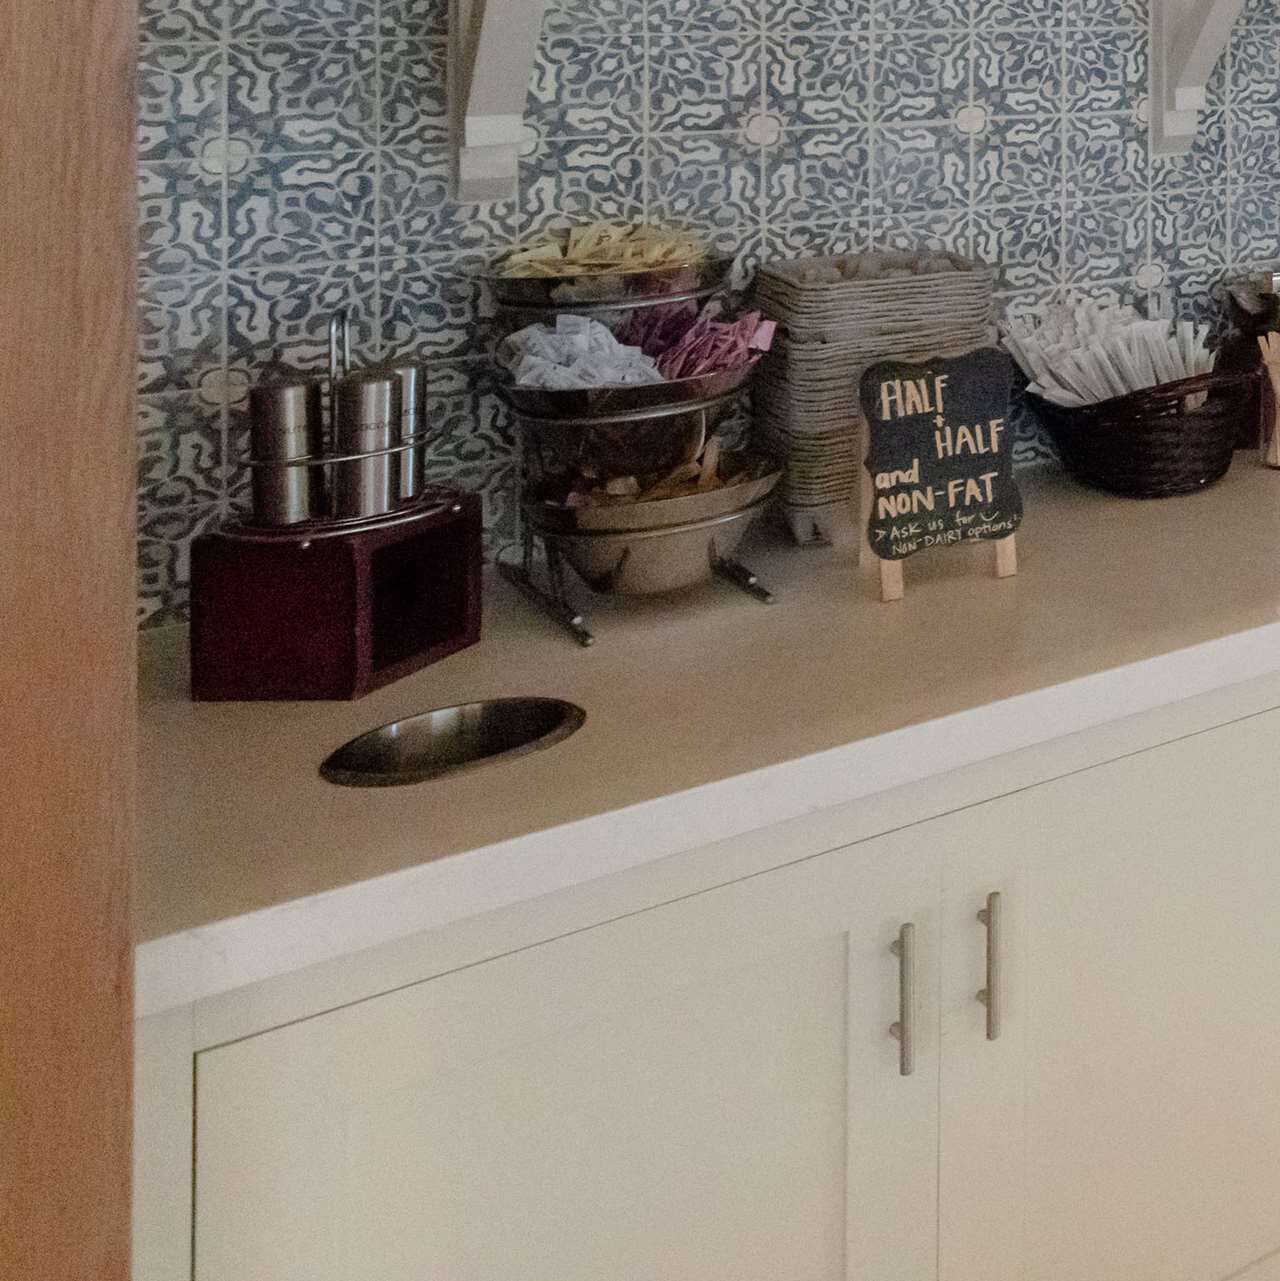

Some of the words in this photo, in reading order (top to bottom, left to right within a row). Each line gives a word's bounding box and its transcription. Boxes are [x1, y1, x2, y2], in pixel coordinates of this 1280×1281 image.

[880, 372, 949, 420] HALF
[934, 418, 1004, 459] HALF
[875, 458, 919, 489] and
[877, 472, 998, 520] NON-FAT
[955, 510, 975, 527] for
